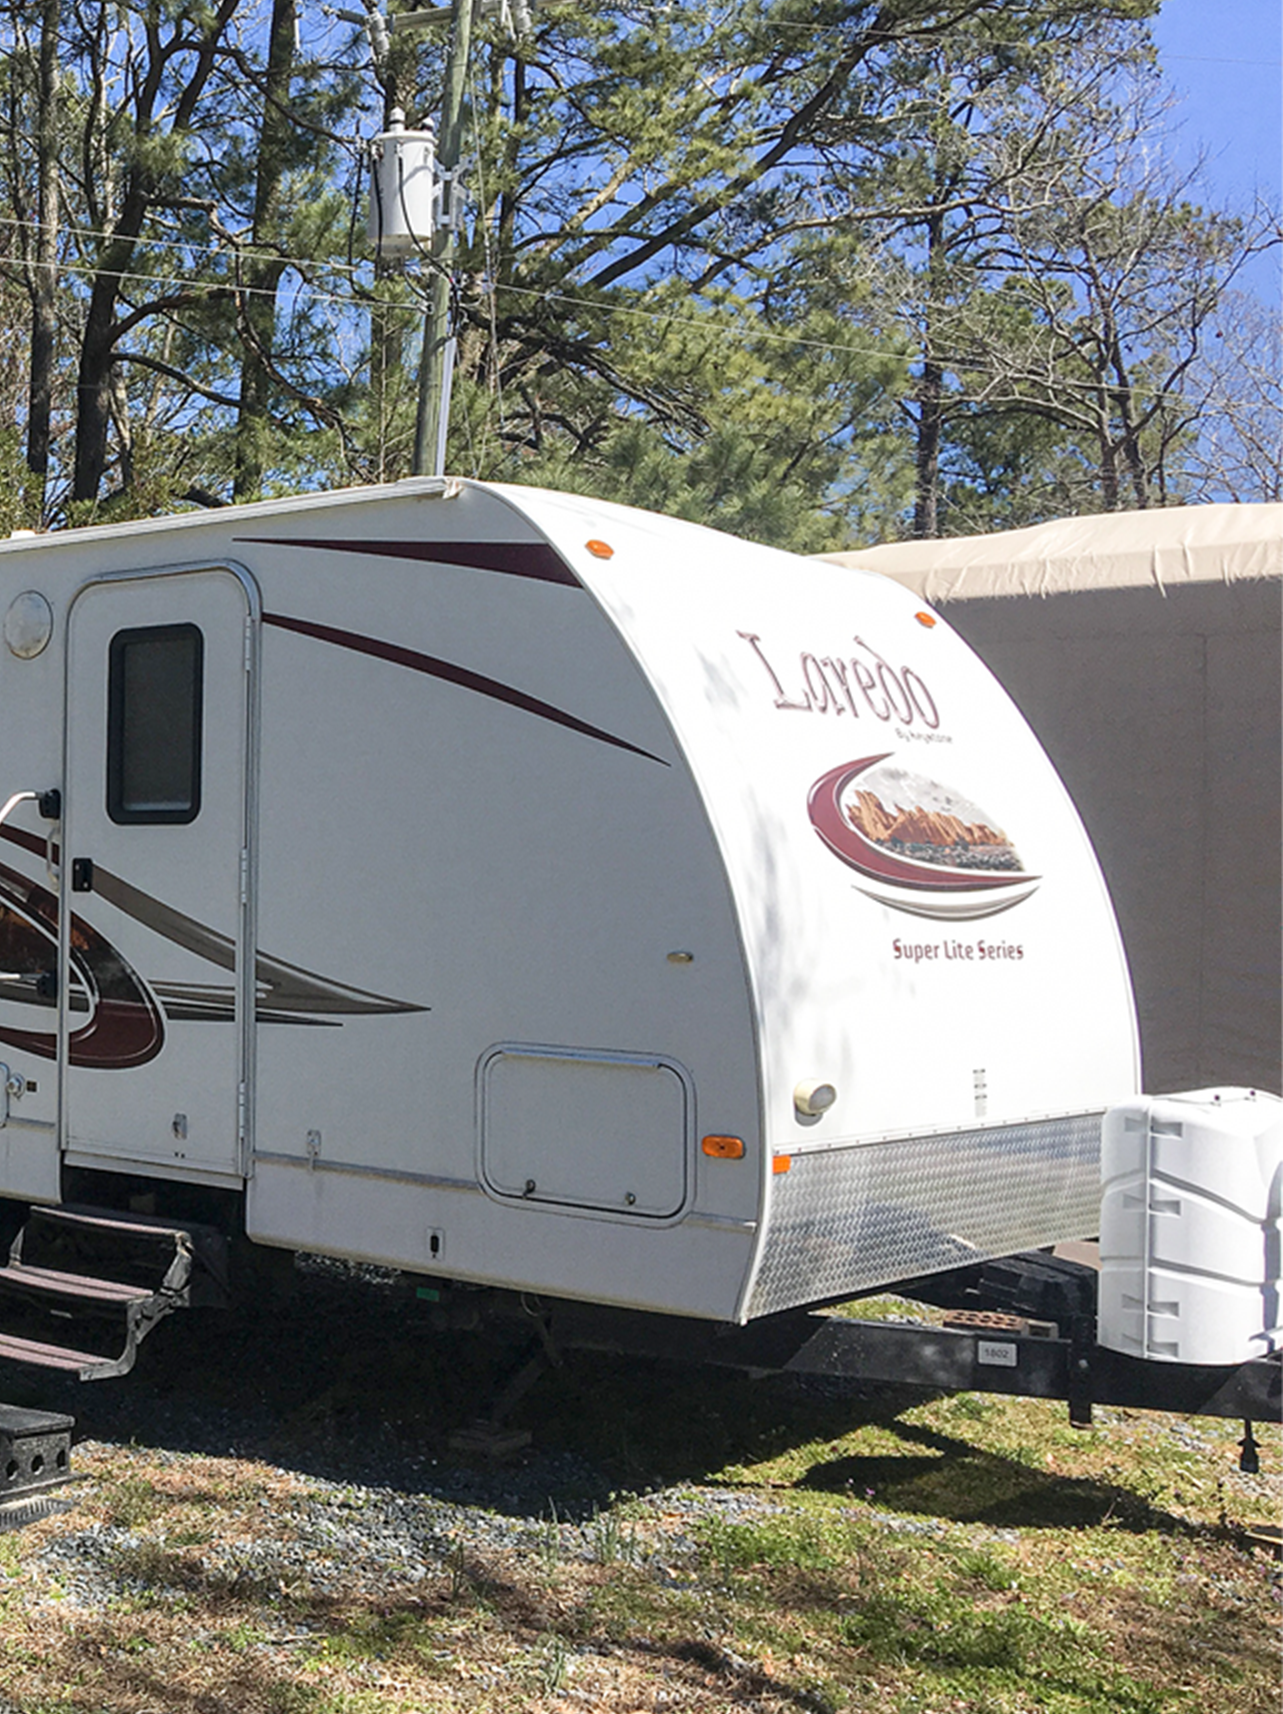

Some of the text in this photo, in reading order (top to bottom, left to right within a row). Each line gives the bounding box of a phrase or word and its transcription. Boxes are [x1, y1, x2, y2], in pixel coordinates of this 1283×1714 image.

[735, 629, 940, 730] Laredo
[892, 938, 1024, 964] Super Lite Series
